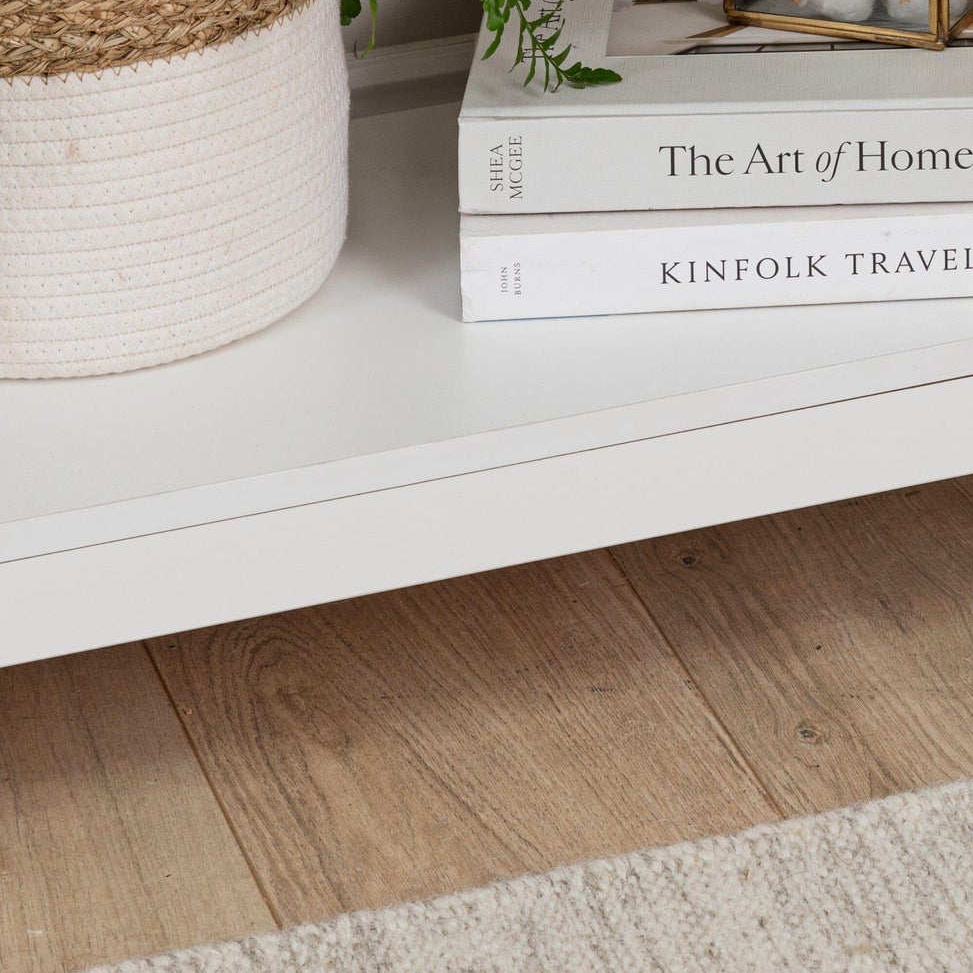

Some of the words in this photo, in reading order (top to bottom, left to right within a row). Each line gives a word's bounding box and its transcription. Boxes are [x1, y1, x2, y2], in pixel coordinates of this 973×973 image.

[490, 144, 503, 191] SHEA
[508, 135, 523, 200] MCGEE
[658, 145, 735, 177] The
[741, 142, 805, 175] Art
[815, 141, 852, 183] of
[500, 266, 508, 293] JOHN
[513, 262, 522, 296] BURNS
[660, 254, 829, 285] KINFOLK
